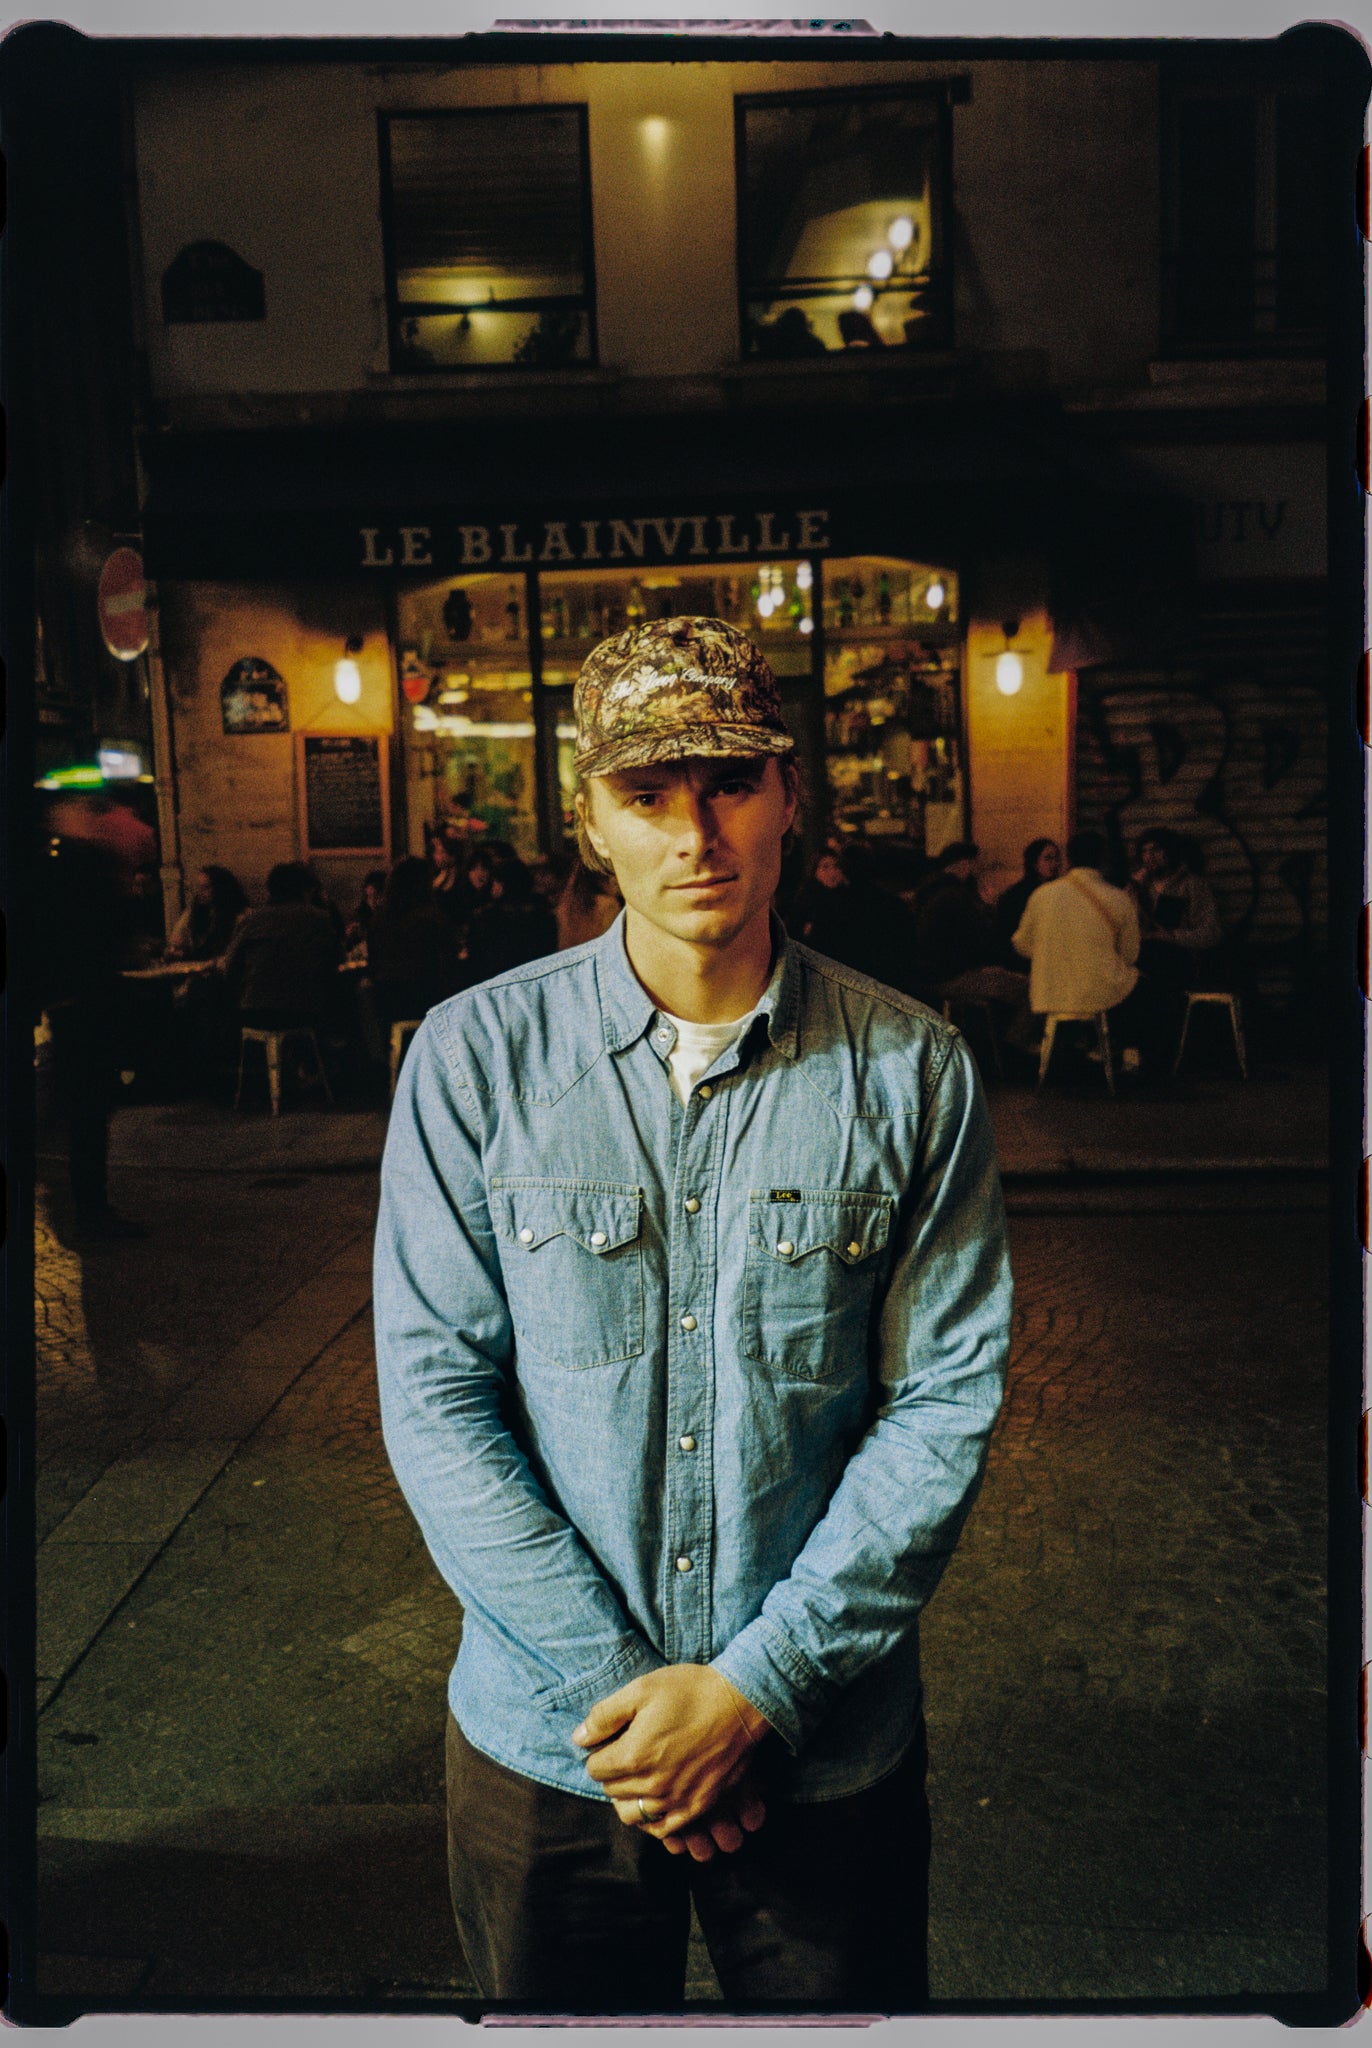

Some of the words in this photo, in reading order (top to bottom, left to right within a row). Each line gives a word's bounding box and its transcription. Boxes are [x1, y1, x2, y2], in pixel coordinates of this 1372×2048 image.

[359, 526, 433, 567] LE
[458, 510, 831, 566] BLAINVILLE
[681, 667, 738, 691] Company
